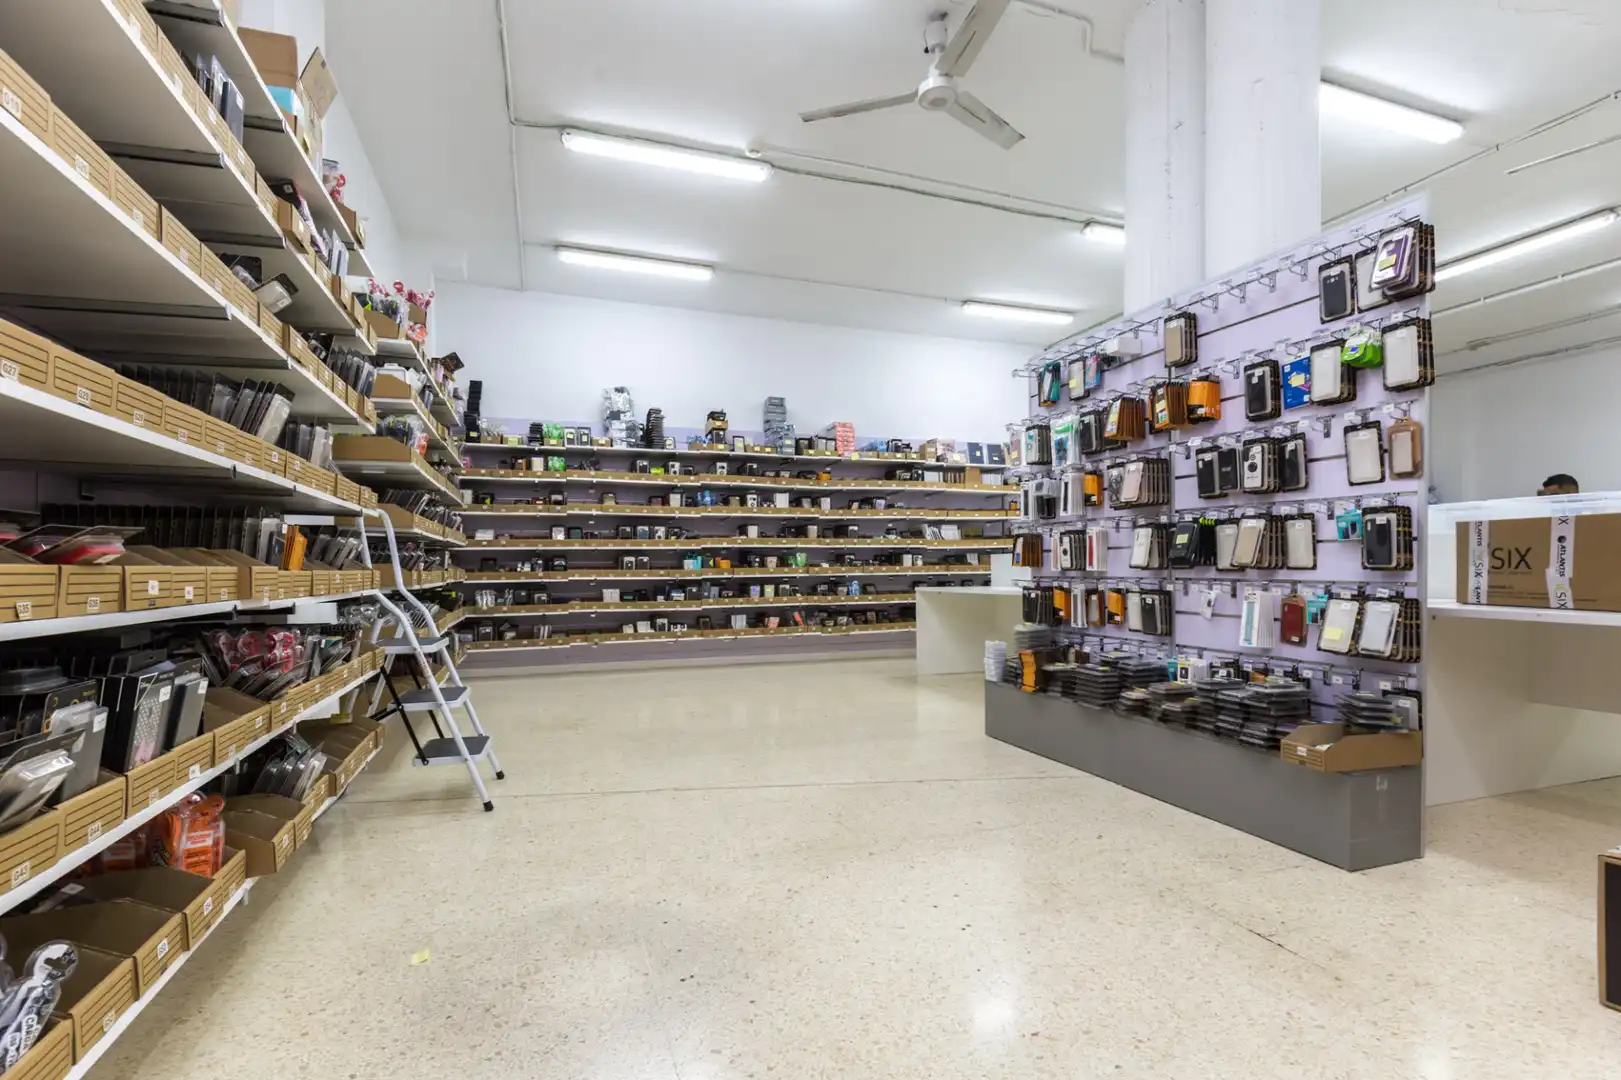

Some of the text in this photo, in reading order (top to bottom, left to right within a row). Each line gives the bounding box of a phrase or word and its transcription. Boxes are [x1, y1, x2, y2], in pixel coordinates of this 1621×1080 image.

[3, 362, 17, 377] G27
[1491, 547, 1533, 570] SIX
[1559, 544, 1567, 577] ATLANTIS
